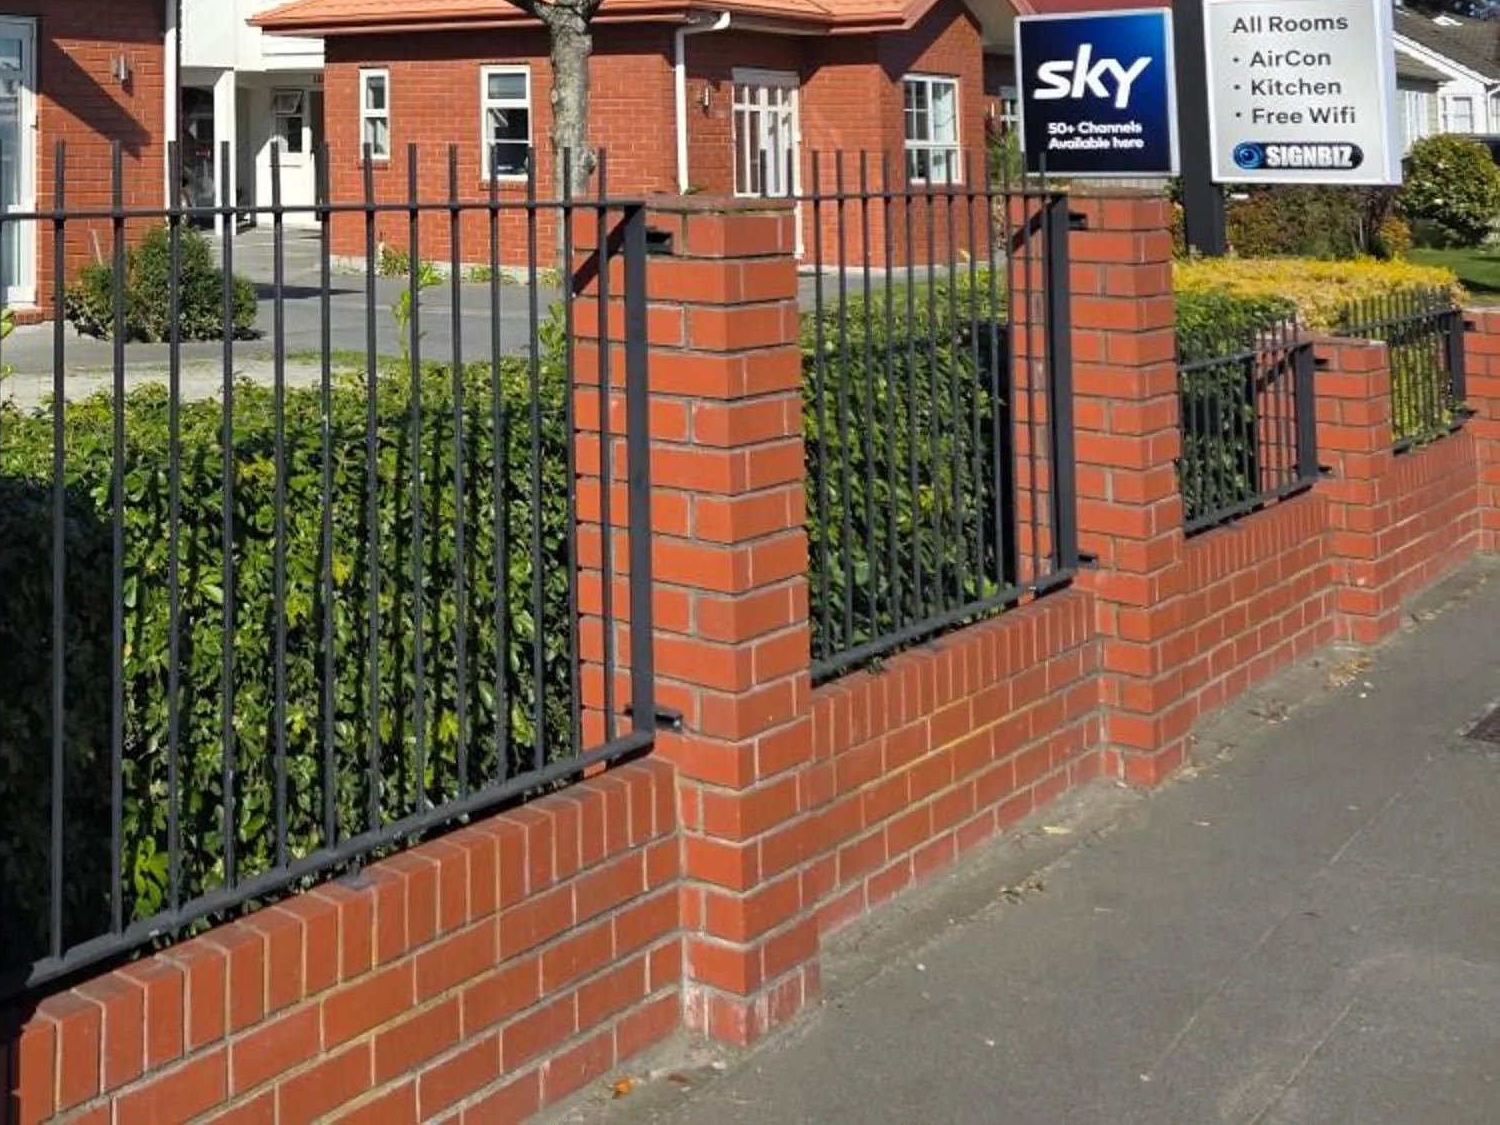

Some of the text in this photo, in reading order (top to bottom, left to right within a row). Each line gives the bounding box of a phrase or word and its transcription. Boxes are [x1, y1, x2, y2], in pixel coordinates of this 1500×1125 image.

[1233, 15, 1349, 33] All Rooms
[1250, 50, 1332, 67] AirCon
[1033, 43, 1152, 109] sky
[1251, 78, 1342, 95] Kitchen
[1252, 106, 1356, 123] Free Wifi
[1047, 120, 1143, 135] 50+ Channels
[1048, 136, 1145, 150] Available here
[1266, 145, 1353, 167] SIGNBIZ
